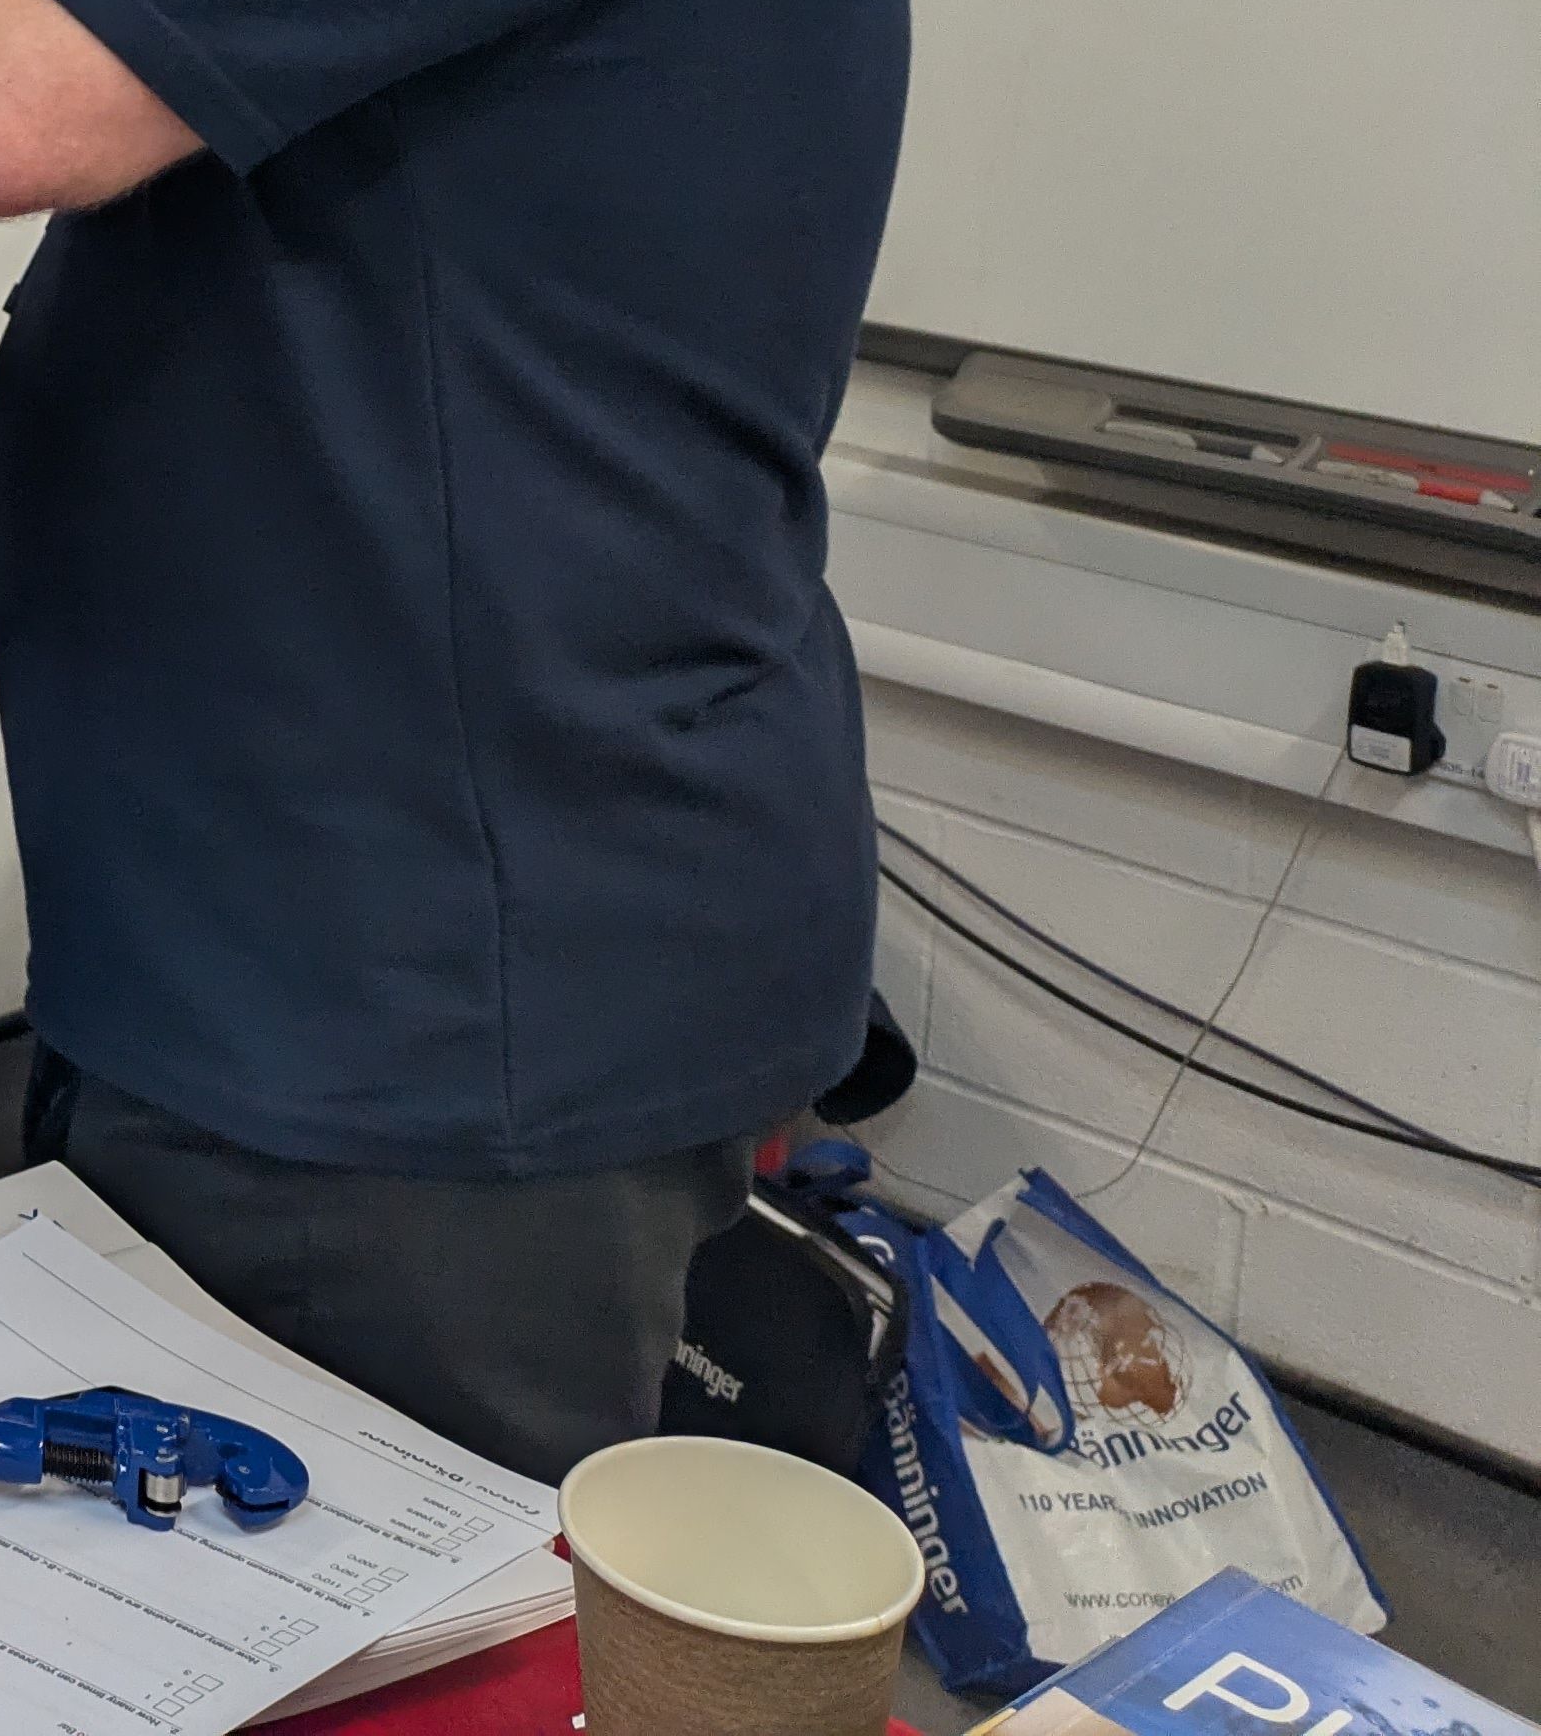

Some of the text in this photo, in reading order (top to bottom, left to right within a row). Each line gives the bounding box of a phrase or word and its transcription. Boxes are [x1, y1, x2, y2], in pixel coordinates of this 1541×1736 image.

[1057, 1492, 1123, 1513] YEAR
[1133, 1471, 1268, 1529] INNOVATION
[363, 1523, 381, 1535] the
[381, 1530, 393, 1539] is
[198, 1537, 246, 1564] operating
[392, 1534, 417, 1550] long
[12, 1544, 40, 1562] Press
[416, 1545, 442, 1559] How
[64, 1571, 84, 1582] our
[246, 1560, 295, 1585] maximum
[83, 1578, 98, 1589] on
[294, 1582, 314, 1594] the
[97, 1585, 125, 1602] there
[313, 1589, 325, 1598] is
[124, 1598, 143, 1610] are
[324, 1595, 352, 1611] What
[142, 1606, 178, 1625] points
[175, 1621, 206, 1639] press
[205, 1636, 236, 1653] many
[7, 1648, 39, 1665] press
[235, 1649, 261, 1666] How
[36, 1662, 59, 1675] you
[56, 1672, 77, 1685] can
[76, 1681, 107, 1700] times
[106, 1695, 137, 1714] many
[135, 1710, 162, 1728] How
